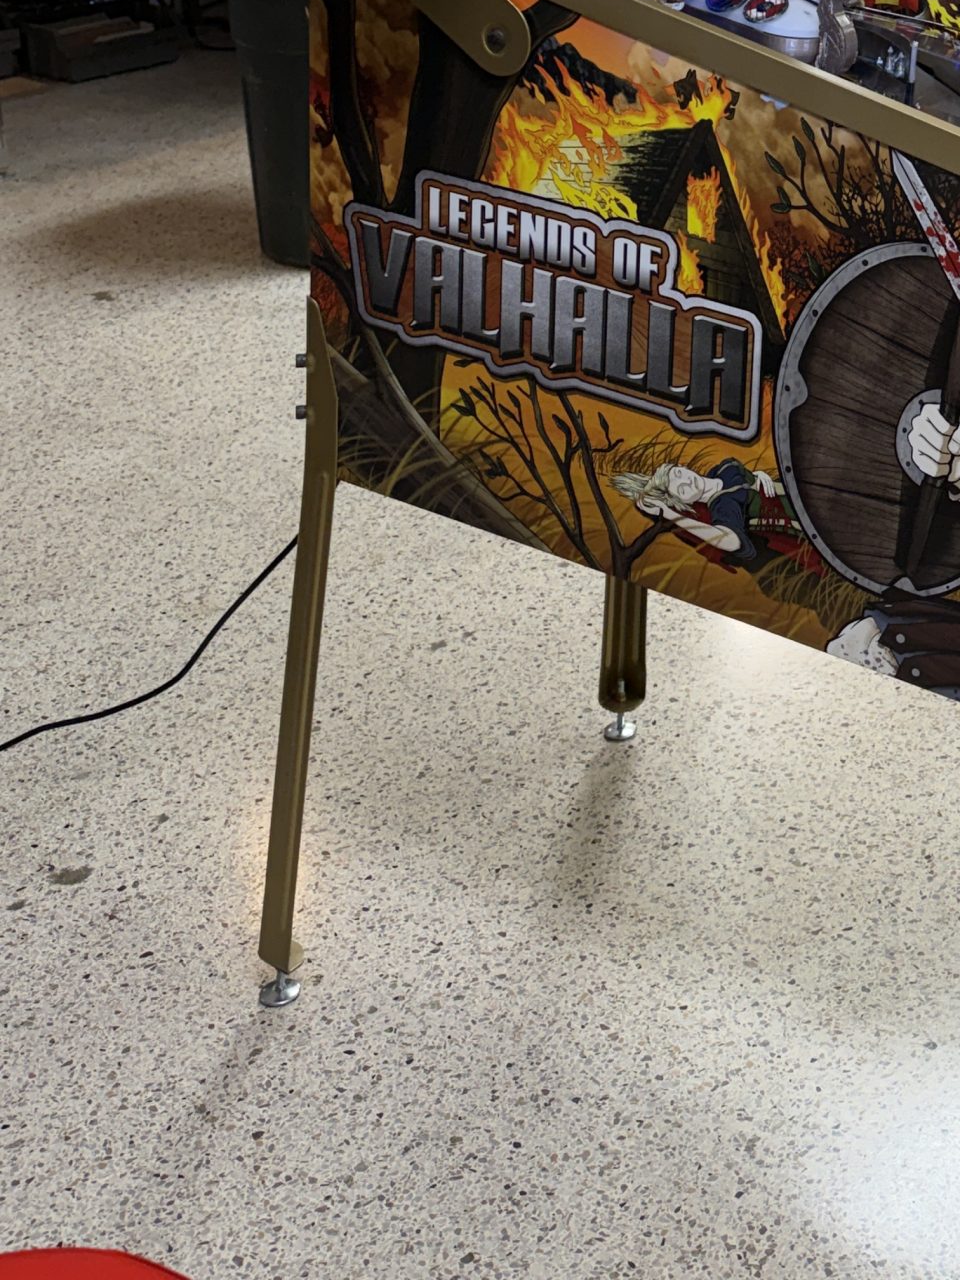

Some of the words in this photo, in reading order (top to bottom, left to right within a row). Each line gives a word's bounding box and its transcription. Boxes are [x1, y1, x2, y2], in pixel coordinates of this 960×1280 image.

[428, 186, 596, 278] LEGENDS
[612, 236, 662, 293] OF
[359, 218, 748, 421] VALHALLA
